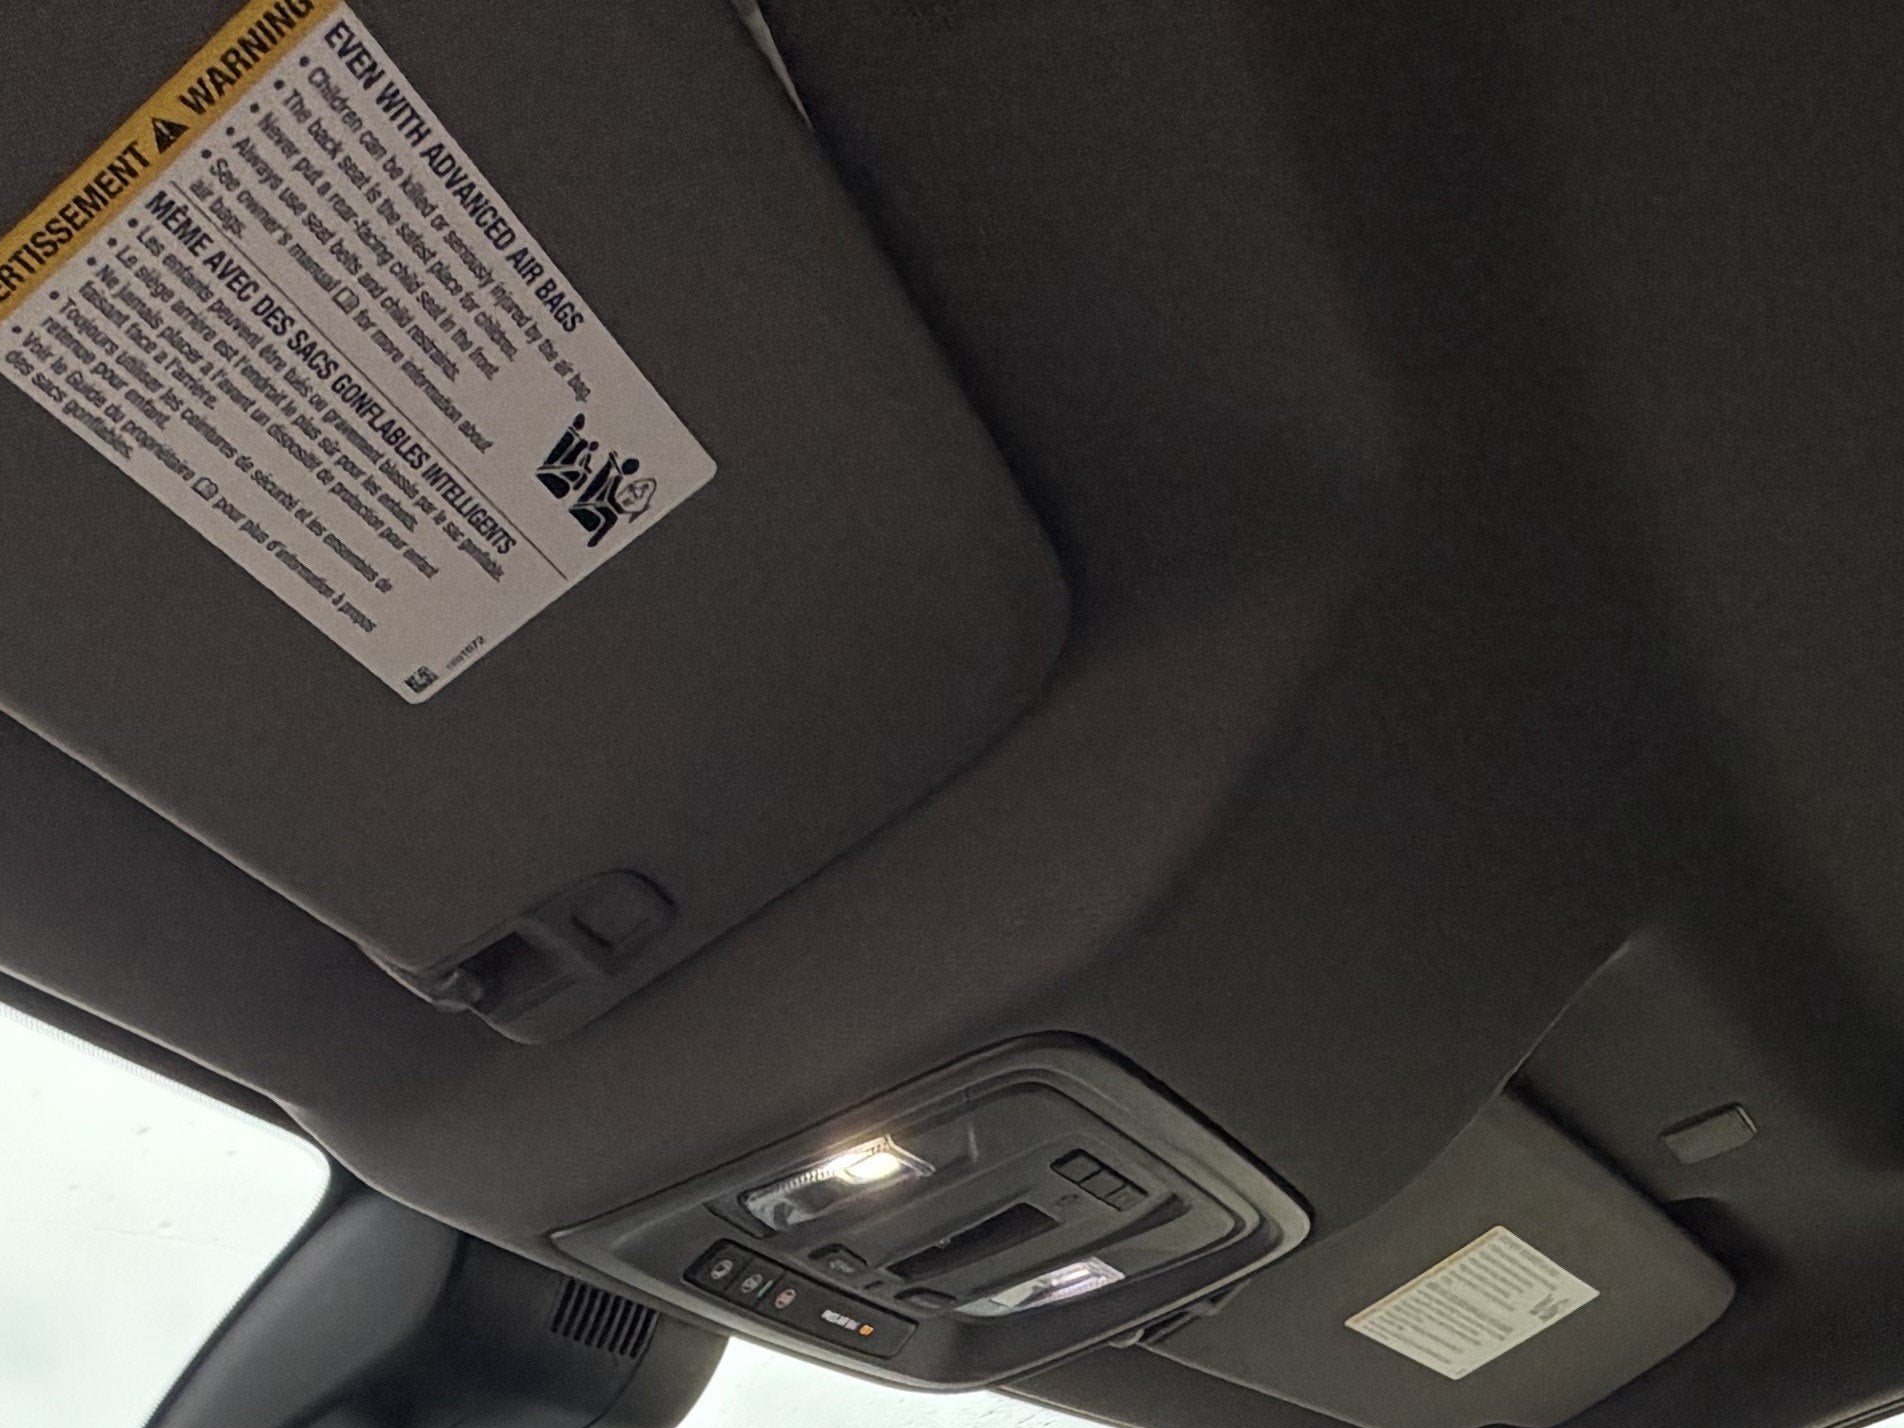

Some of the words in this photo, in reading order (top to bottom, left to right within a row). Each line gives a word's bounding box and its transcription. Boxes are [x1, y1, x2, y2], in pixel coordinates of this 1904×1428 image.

[178, 0, 313, 115] WARNING
[322, 18, 386, 91] EVEN
[372, 80, 433, 149] WITH
[418, 137, 518, 253] ADVANCED
[504, 242, 546, 287] AIR
[532, 277, 585, 335] BAGS
[144, 185, 218, 258] MÊME
[201, 245, 262, 304] AVEC
[249, 293, 297, 339] DES
[283, 327, 341, 382] SACS
[327, 371, 431, 472] GONFLABLES
[418, 461, 517, 557] INTELLIGENTS
